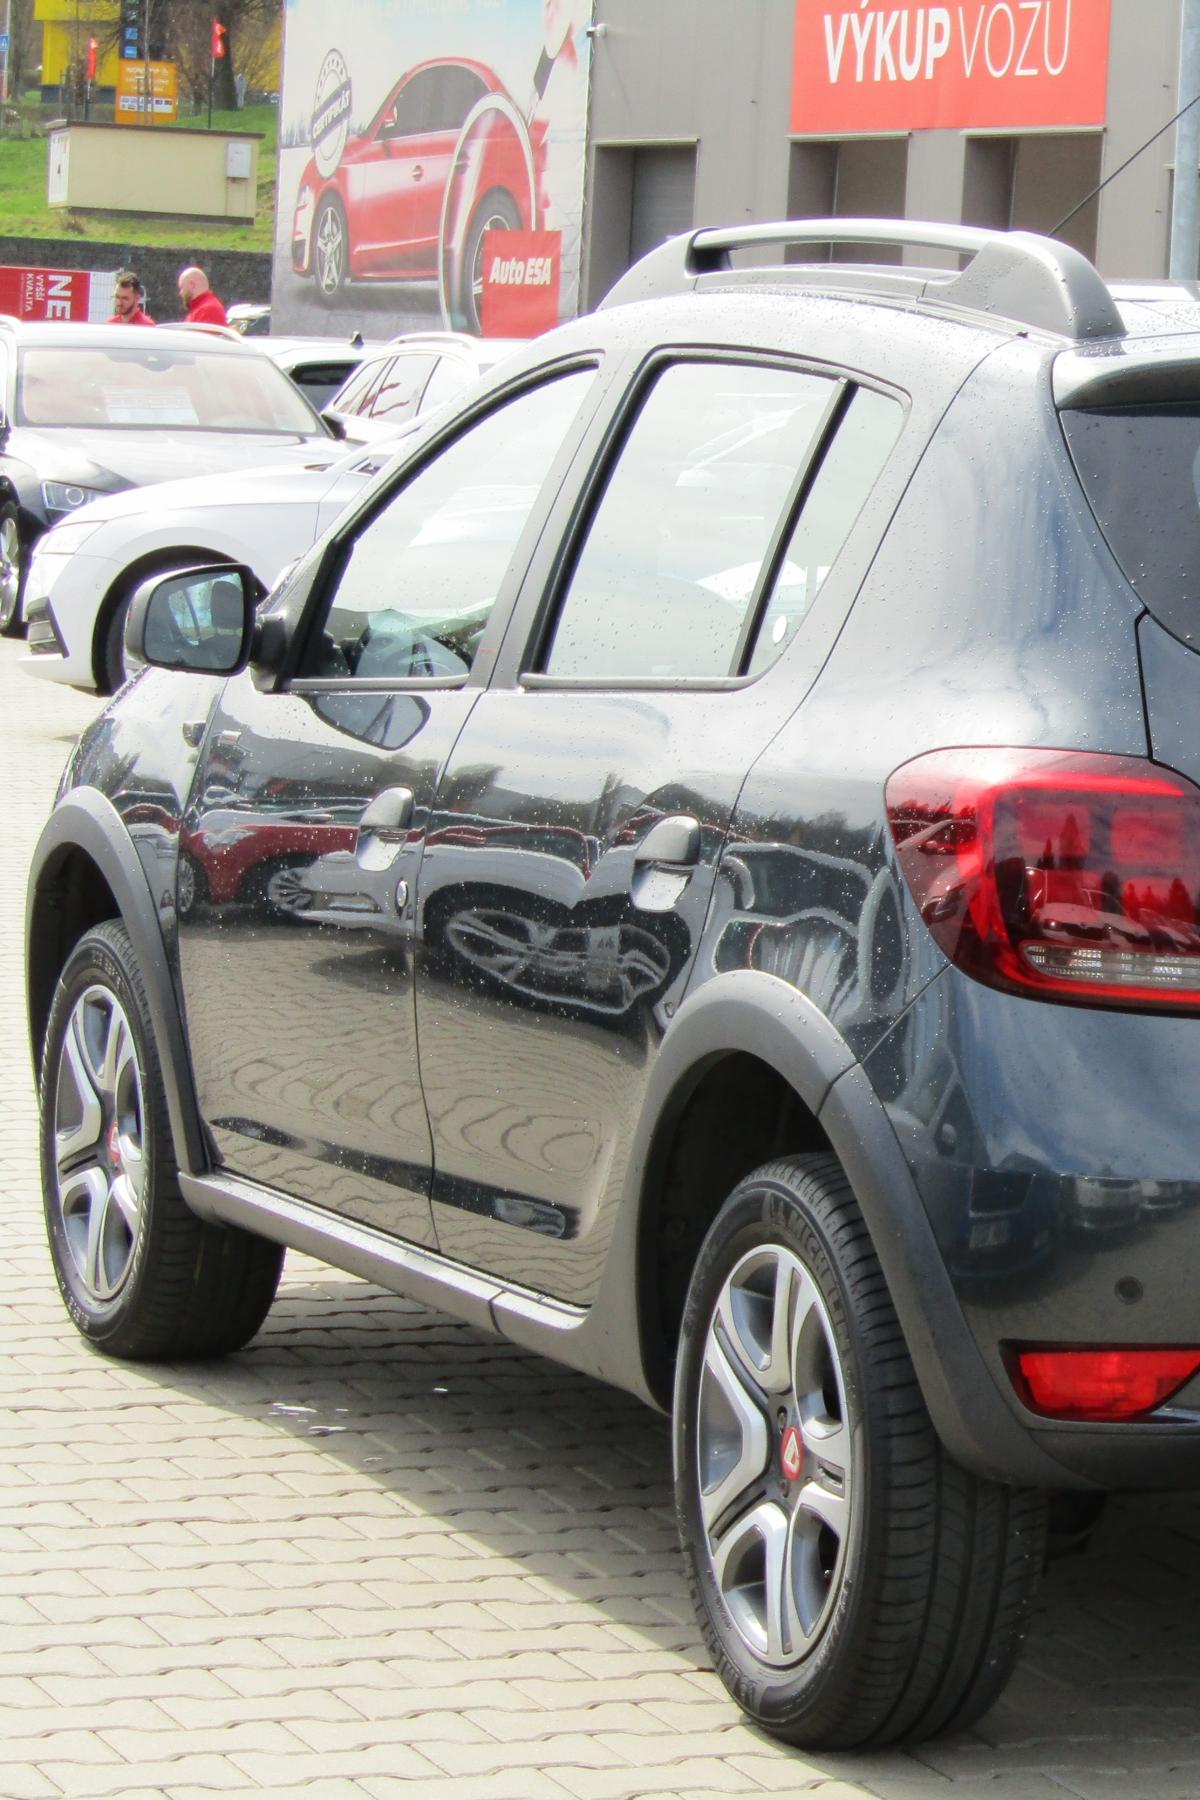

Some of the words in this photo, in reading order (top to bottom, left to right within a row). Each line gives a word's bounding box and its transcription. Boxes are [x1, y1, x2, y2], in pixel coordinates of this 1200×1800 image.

[824, 0, 950, 83] VÝKUP
[489, 257, 524, 285] Auto
[525, 258, 552, 285] ESA
[25, 273, 34, 312] KVALITA
